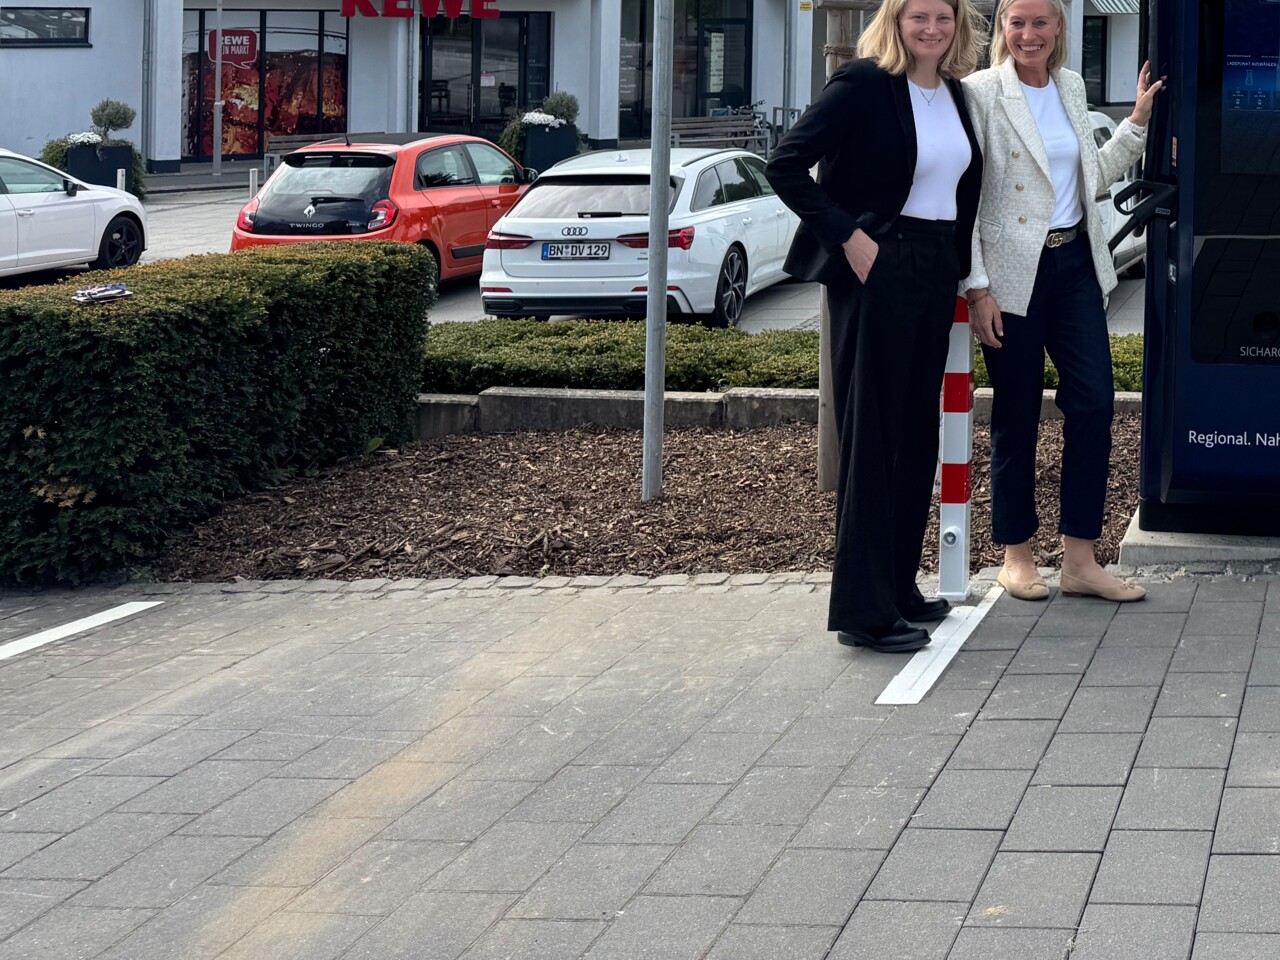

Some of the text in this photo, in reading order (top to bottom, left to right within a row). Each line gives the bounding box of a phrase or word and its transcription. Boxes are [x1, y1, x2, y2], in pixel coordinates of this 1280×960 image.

[231, 45, 249, 55] MARKT
[549, 245, 608, 256] BN DV 129
[1188, 430, 1251, 448] Regional.
